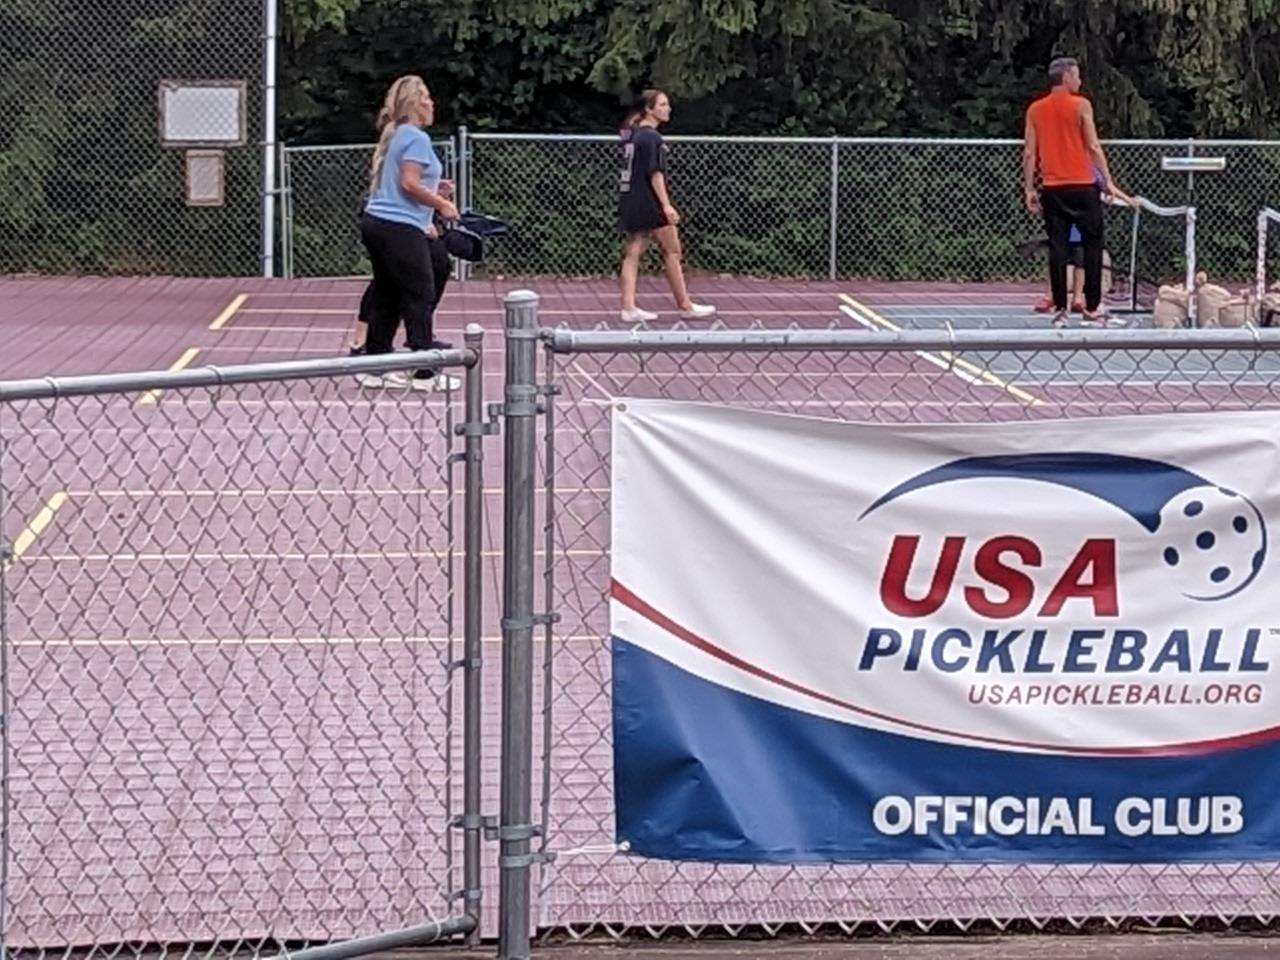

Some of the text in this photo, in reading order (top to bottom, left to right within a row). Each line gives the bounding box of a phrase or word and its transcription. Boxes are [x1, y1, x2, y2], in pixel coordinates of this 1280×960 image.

[880, 534, 1119, 618] USA
[858, 628, 1270, 673] PICKLEBALL
[968, 683, 1263, 705] USAPICKLEBALL.ORG
[873, 795, 1244, 836] OFFICIAL CLUB
